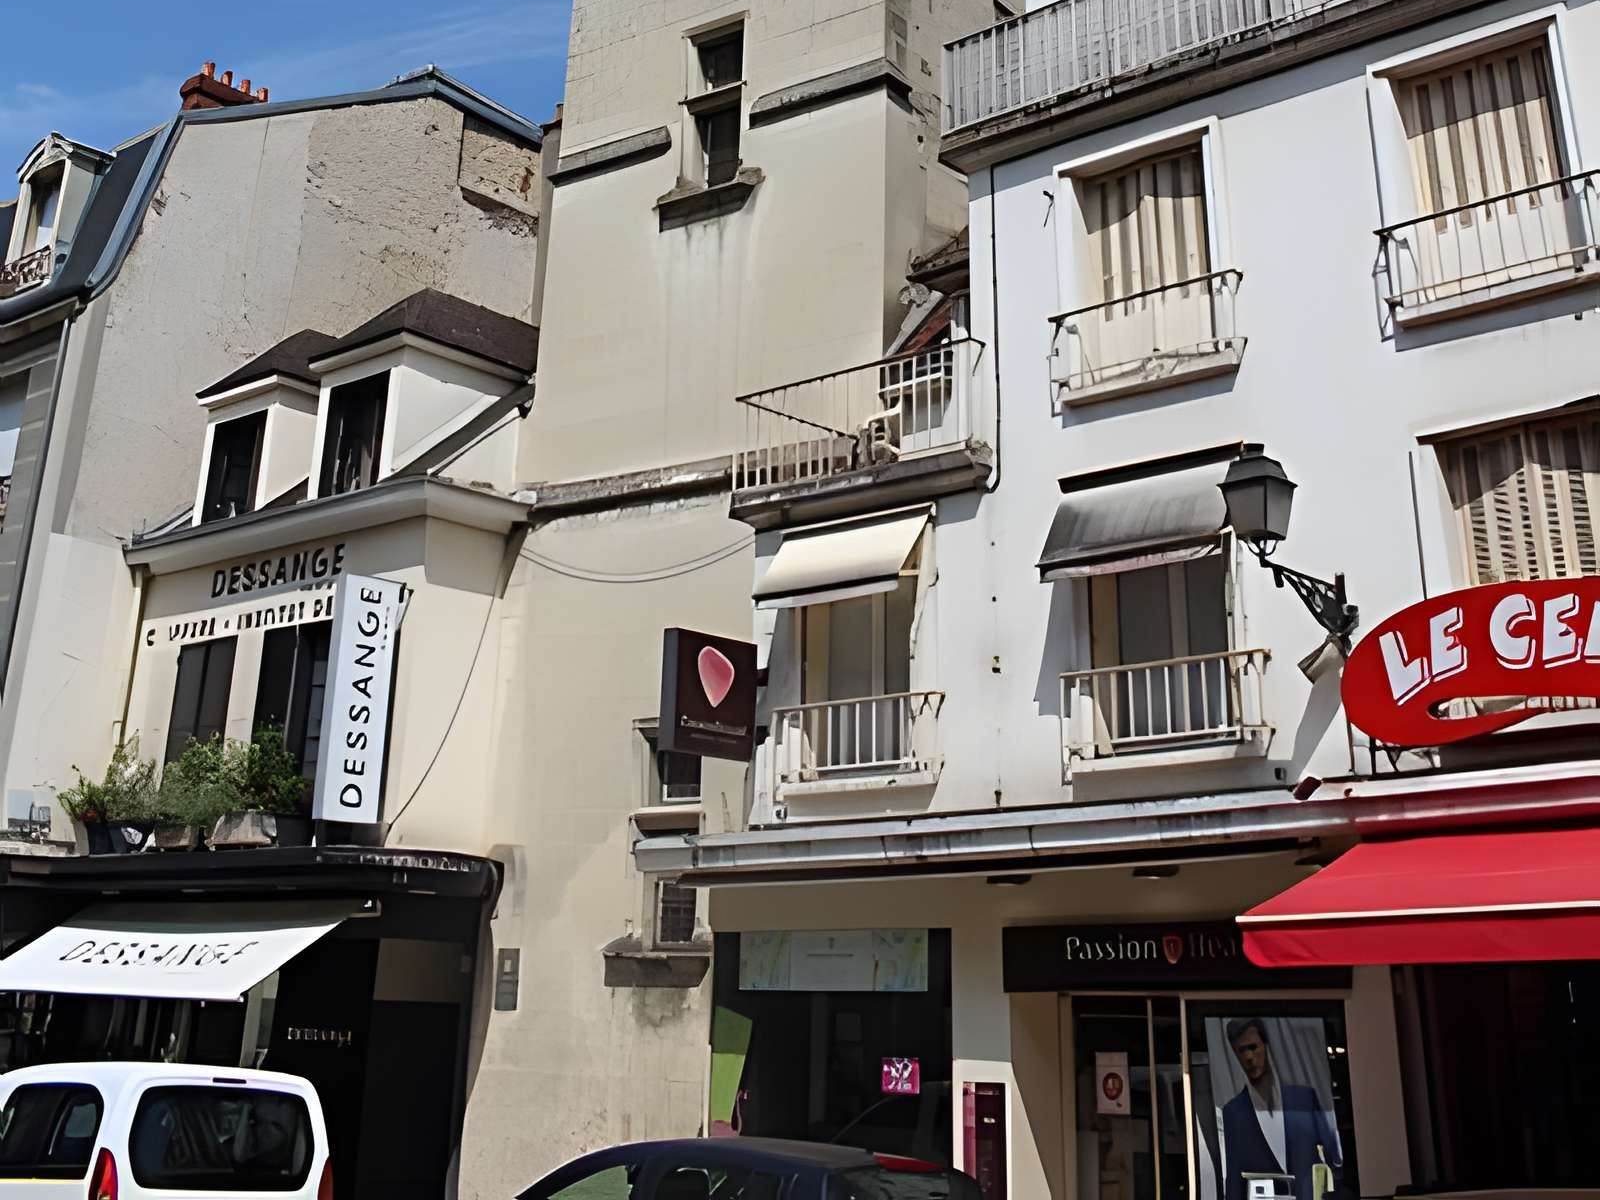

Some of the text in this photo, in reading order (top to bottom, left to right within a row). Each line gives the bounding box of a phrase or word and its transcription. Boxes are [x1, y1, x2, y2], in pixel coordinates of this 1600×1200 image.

[211, 543, 346, 599] DESSANGE
[1378, 606, 1468, 707] LE
[339, 587, 383, 809] DESSANGE
[1066, 933, 1157, 961] Passion
